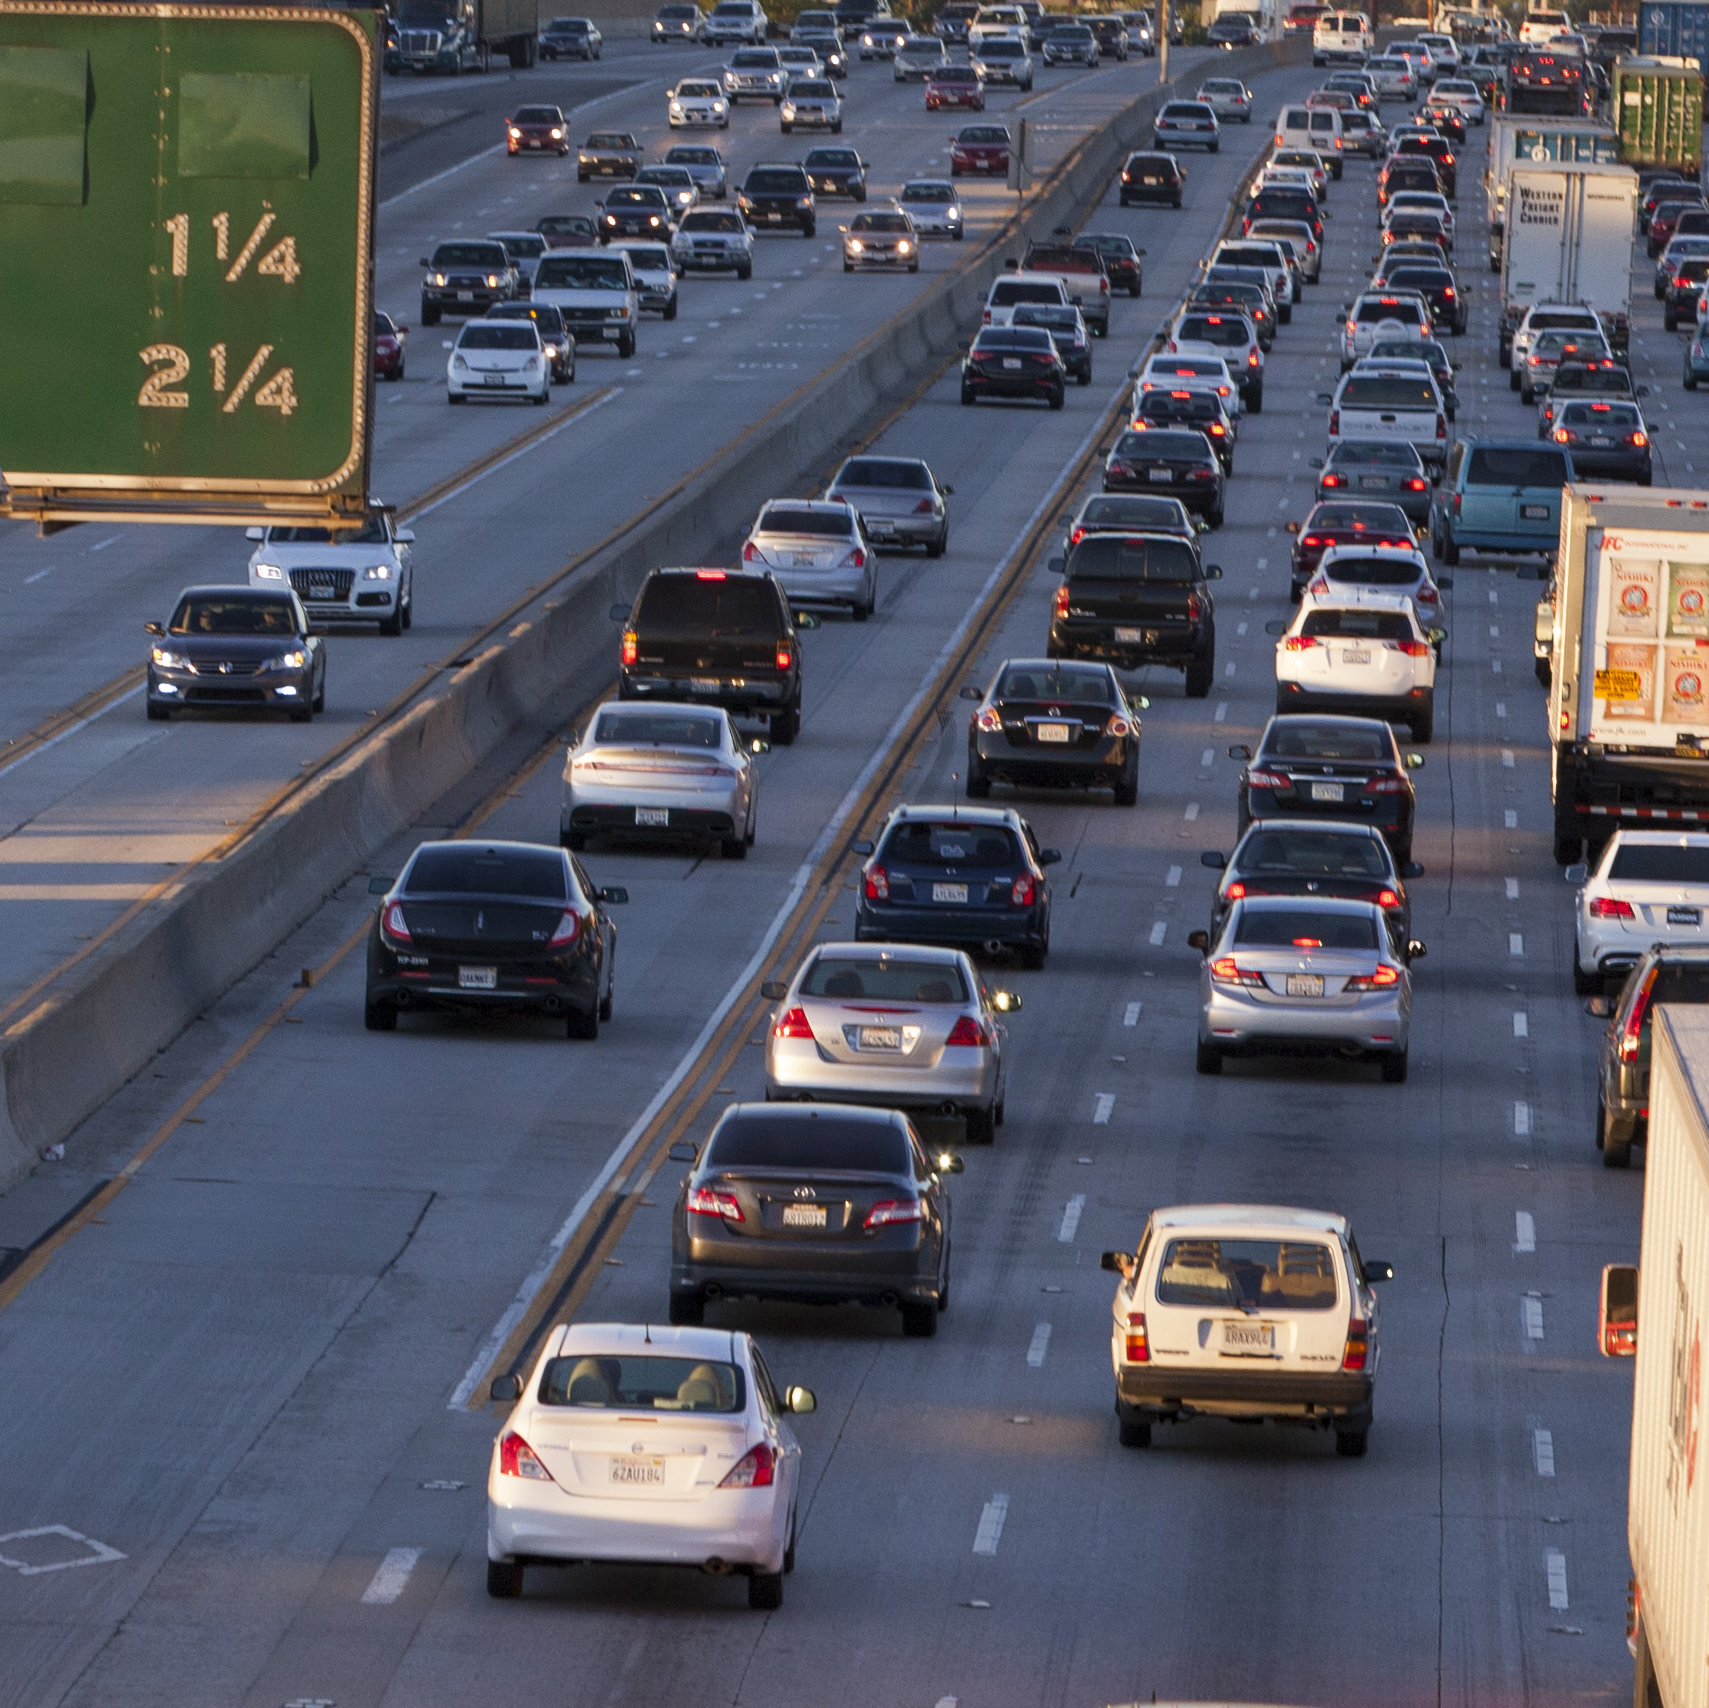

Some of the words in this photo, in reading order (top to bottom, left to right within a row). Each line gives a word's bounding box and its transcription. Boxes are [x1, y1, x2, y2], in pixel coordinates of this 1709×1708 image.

[1520, 186, 1563, 201] WESTERN
[1522, 200, 1559, 213] FREIGHT
[1520, 212, 1558, 225] CARRIER
